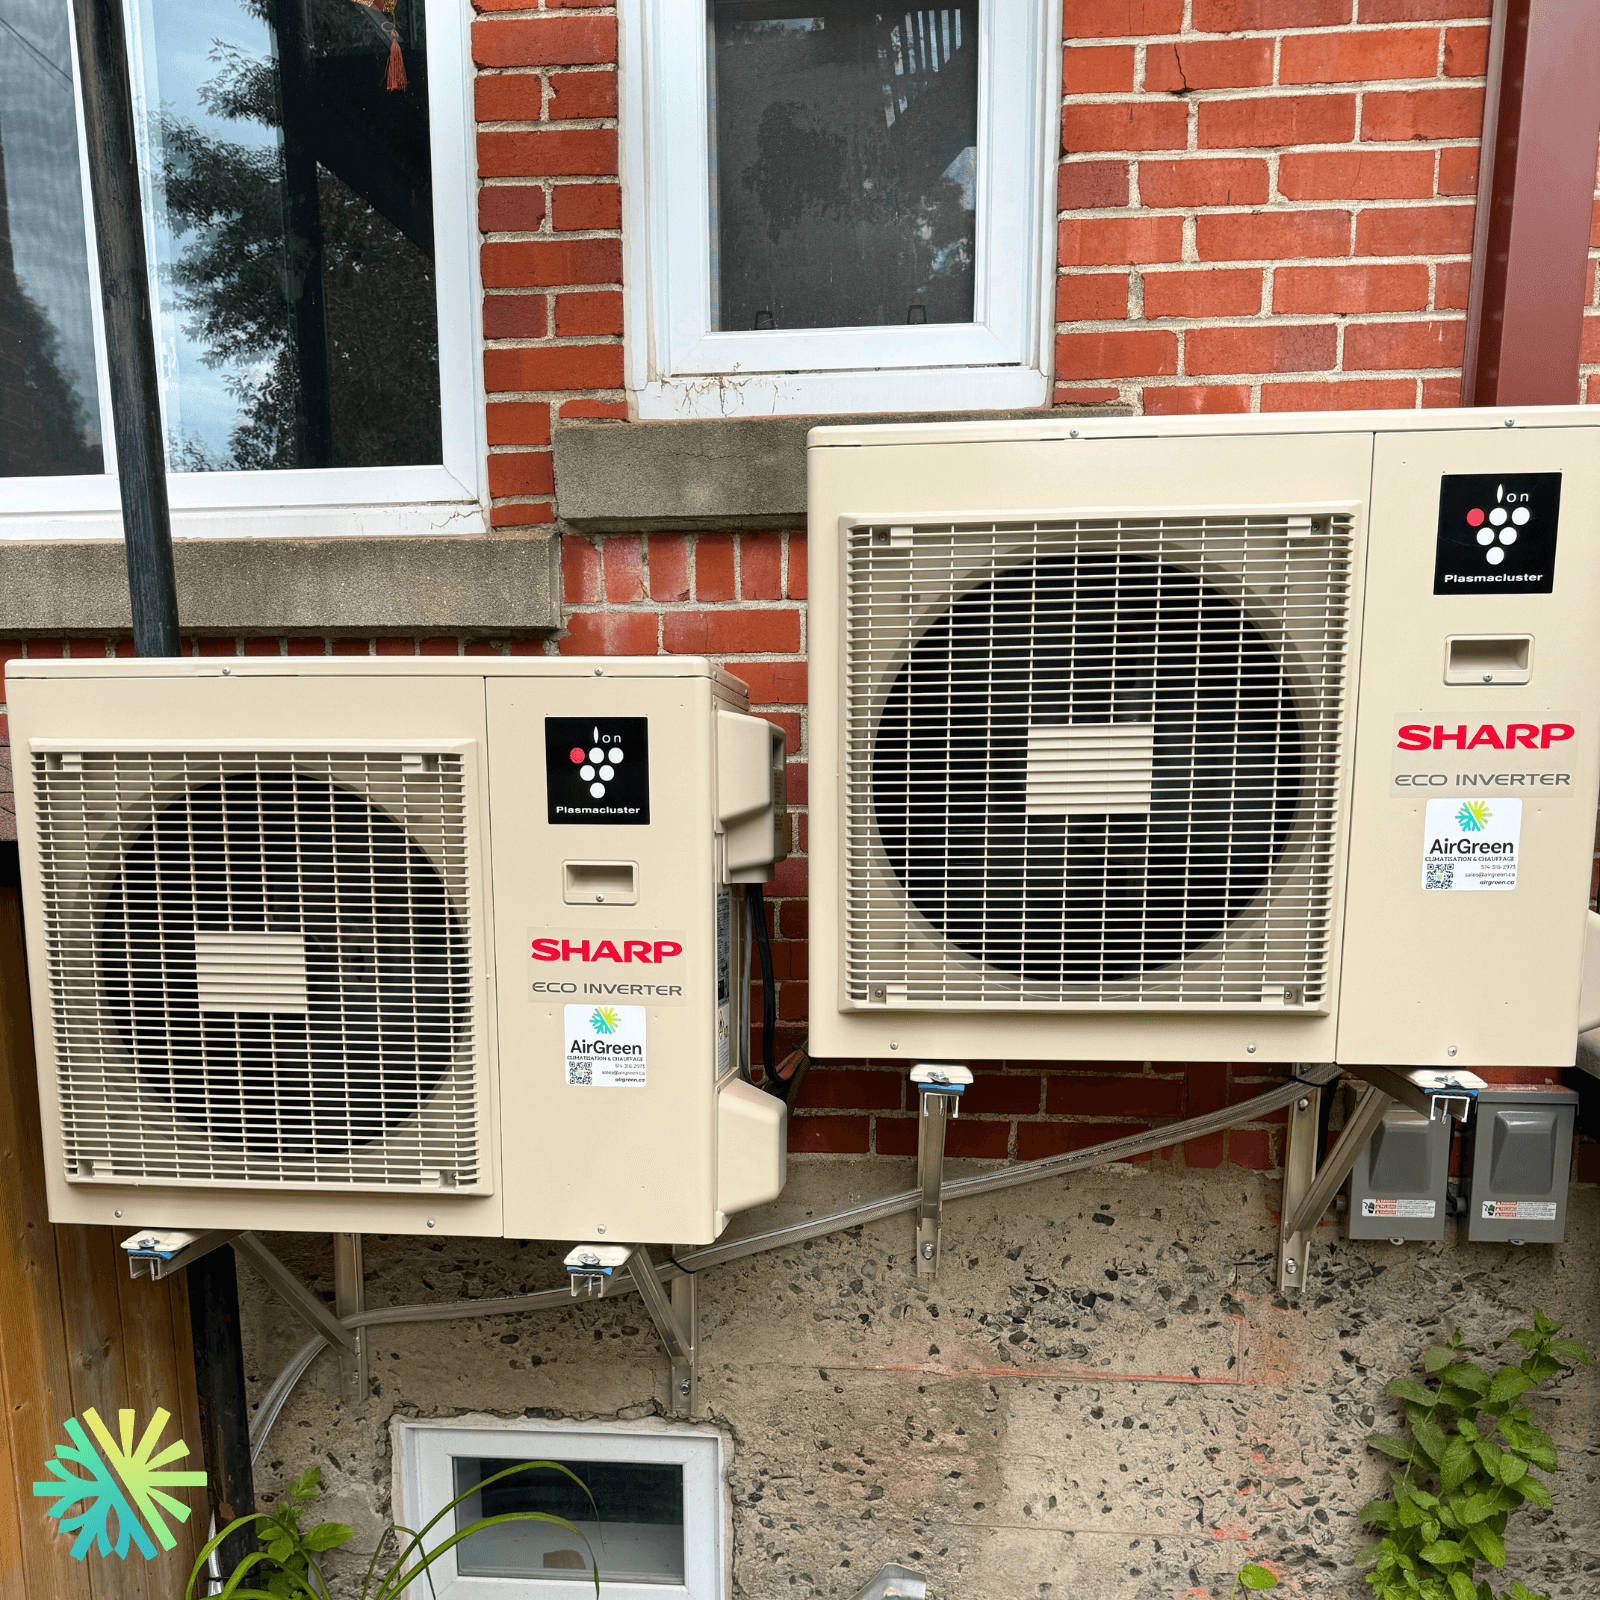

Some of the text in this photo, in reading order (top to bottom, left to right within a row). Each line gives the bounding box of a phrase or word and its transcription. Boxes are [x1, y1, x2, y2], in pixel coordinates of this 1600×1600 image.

[1496, 484, 1529, 503] Ion
[1444, 574, 1543, 583] Plasmacluster
[593, 726, 622, 744] Ion
[1397, 723, 1575, 751] SHARP
[1394, 773, 1571, 786] ECO INVERTER
[556, 806, 641, 814] Plasmacluster
[1429, 838, 1514, 854] AirGreen
[531, 938, 683, 963] SHARP
[532, 982, 682, 996] ECO INVERTER
[570, 1039, 642, 1055] AirGreen
